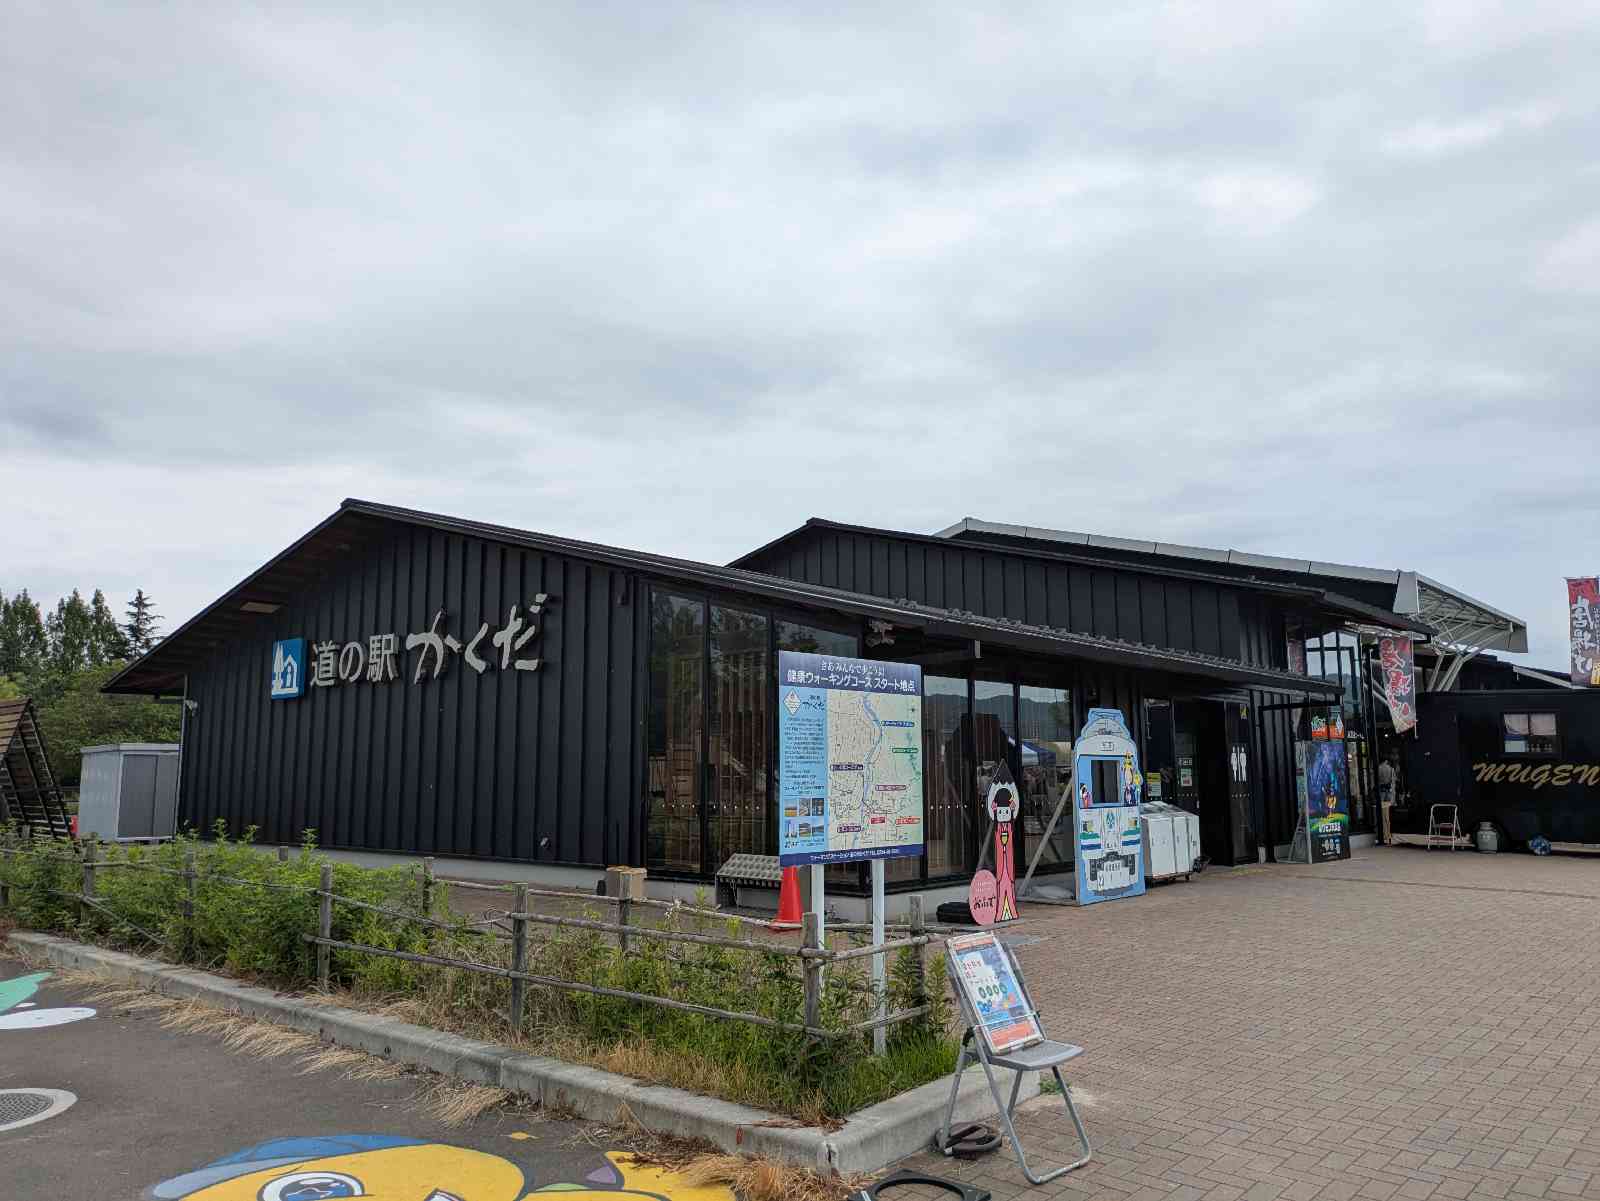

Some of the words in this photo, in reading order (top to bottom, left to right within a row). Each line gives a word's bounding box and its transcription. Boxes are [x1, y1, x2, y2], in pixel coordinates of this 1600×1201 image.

[310, 633, 399, 687] 道の駅
[405, 593, 548, 685] かくだ
[1472, 762, 1600, 790] MUGEN
